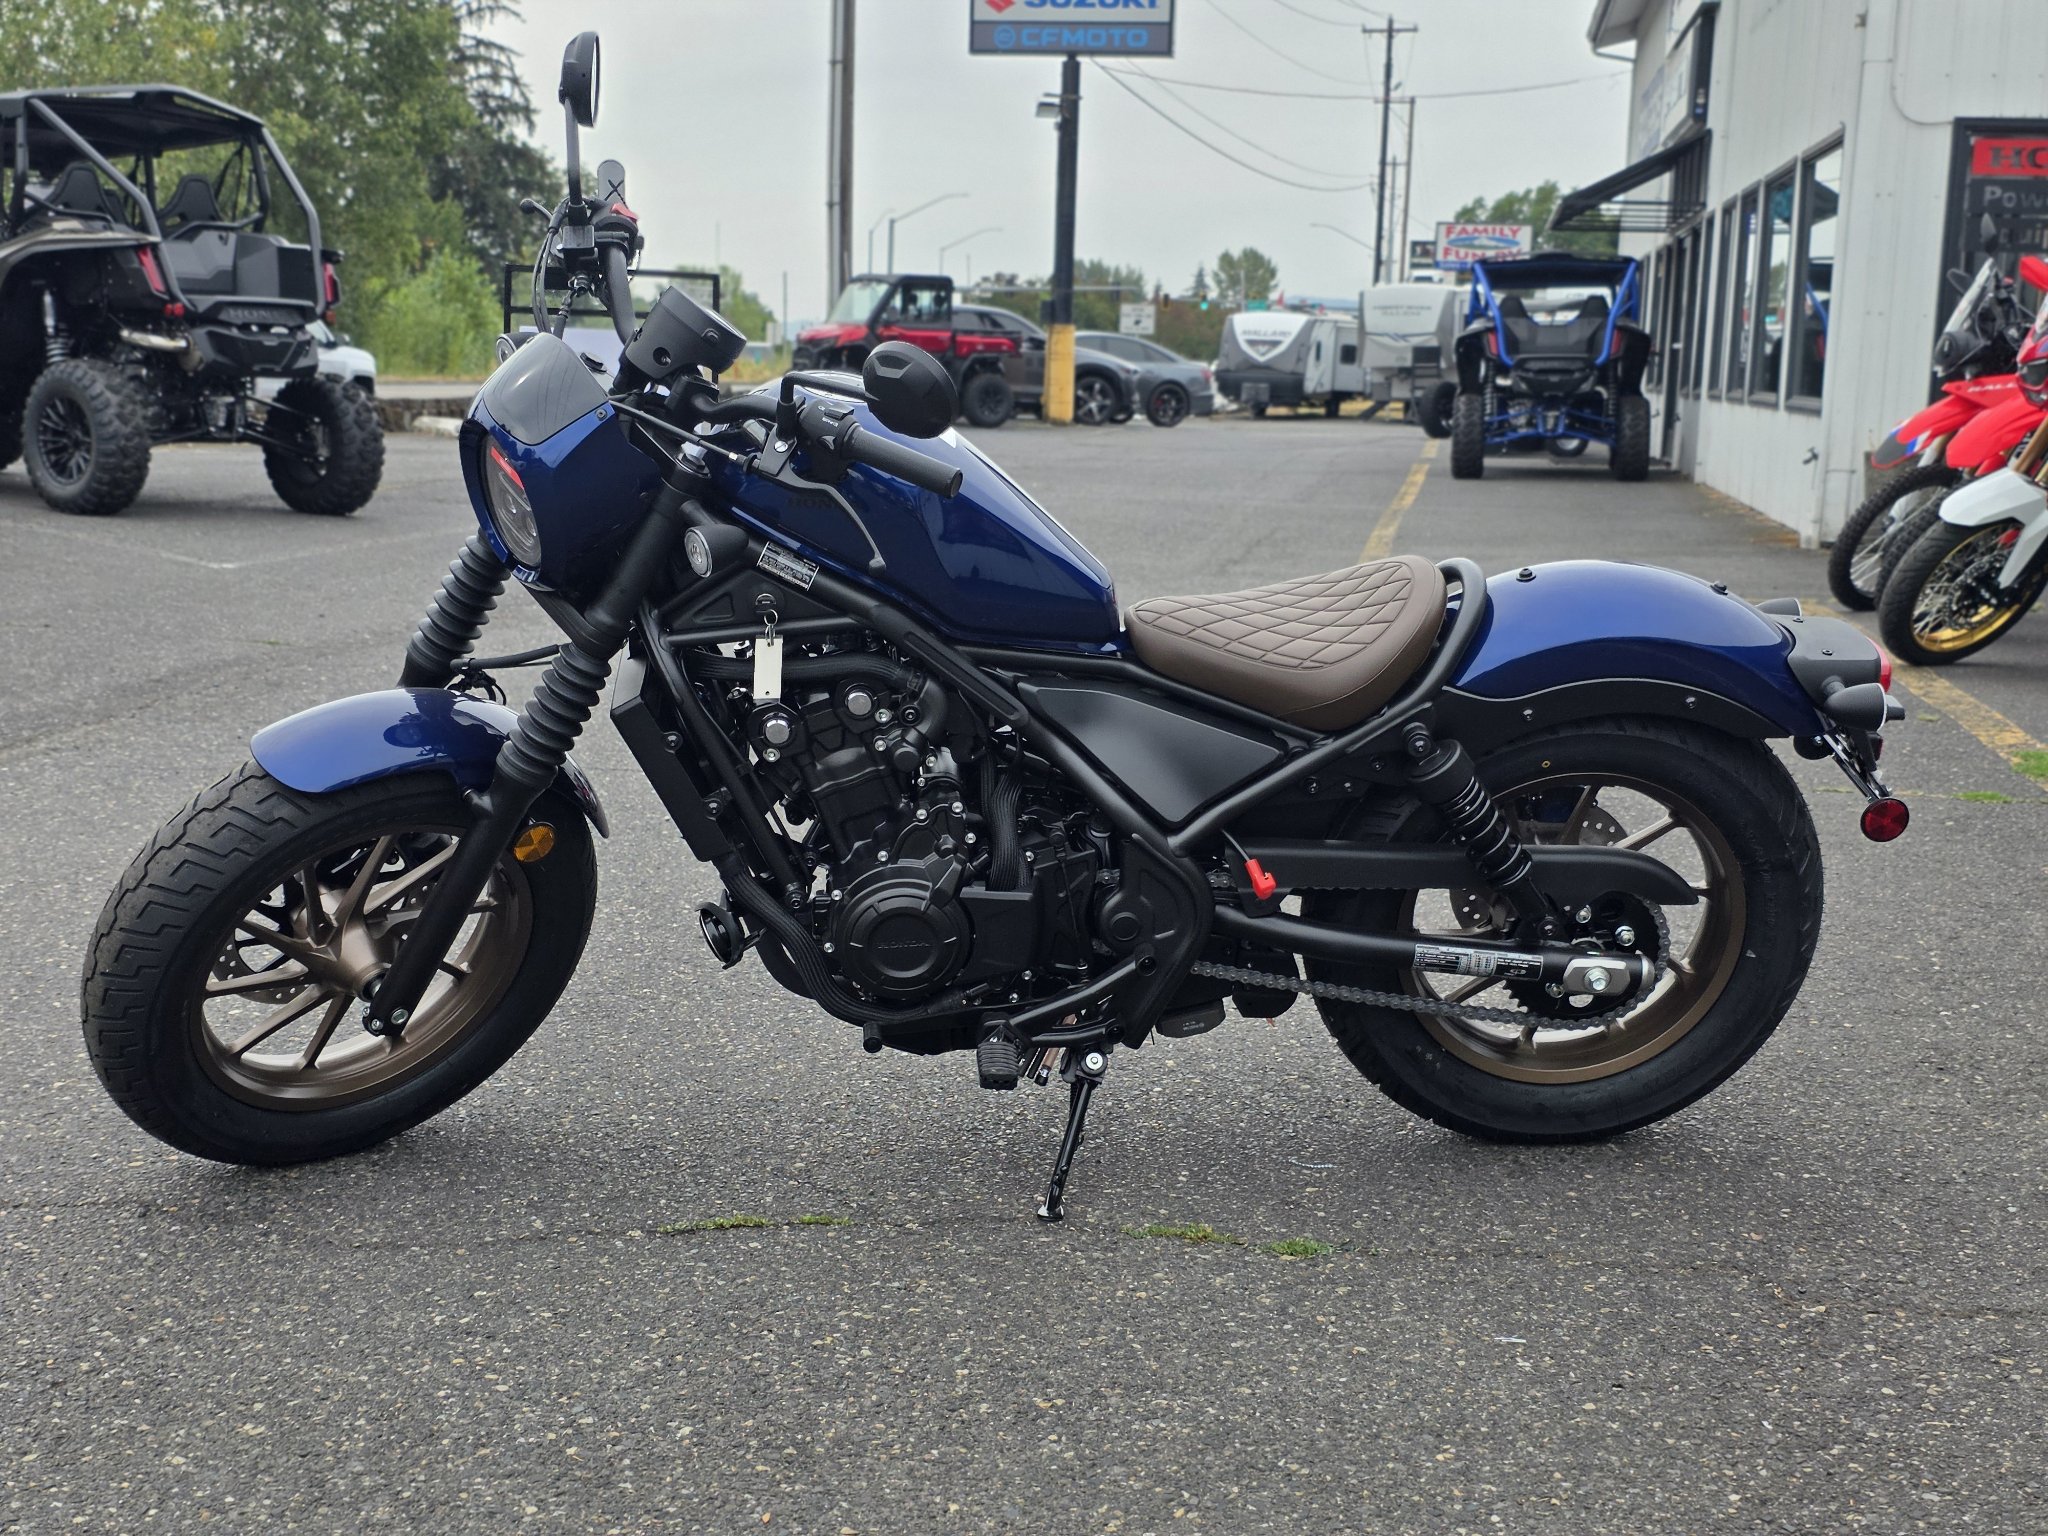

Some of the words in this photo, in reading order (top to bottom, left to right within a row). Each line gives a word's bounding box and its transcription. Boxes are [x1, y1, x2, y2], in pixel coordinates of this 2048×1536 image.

[1021, 27, 1149, 48] CFMOTO
[1984, 185, 2048, 208] Pow
[1444, 224, 1521, 239] FAMILY
[1442, 246, 1487, 260] FUN
